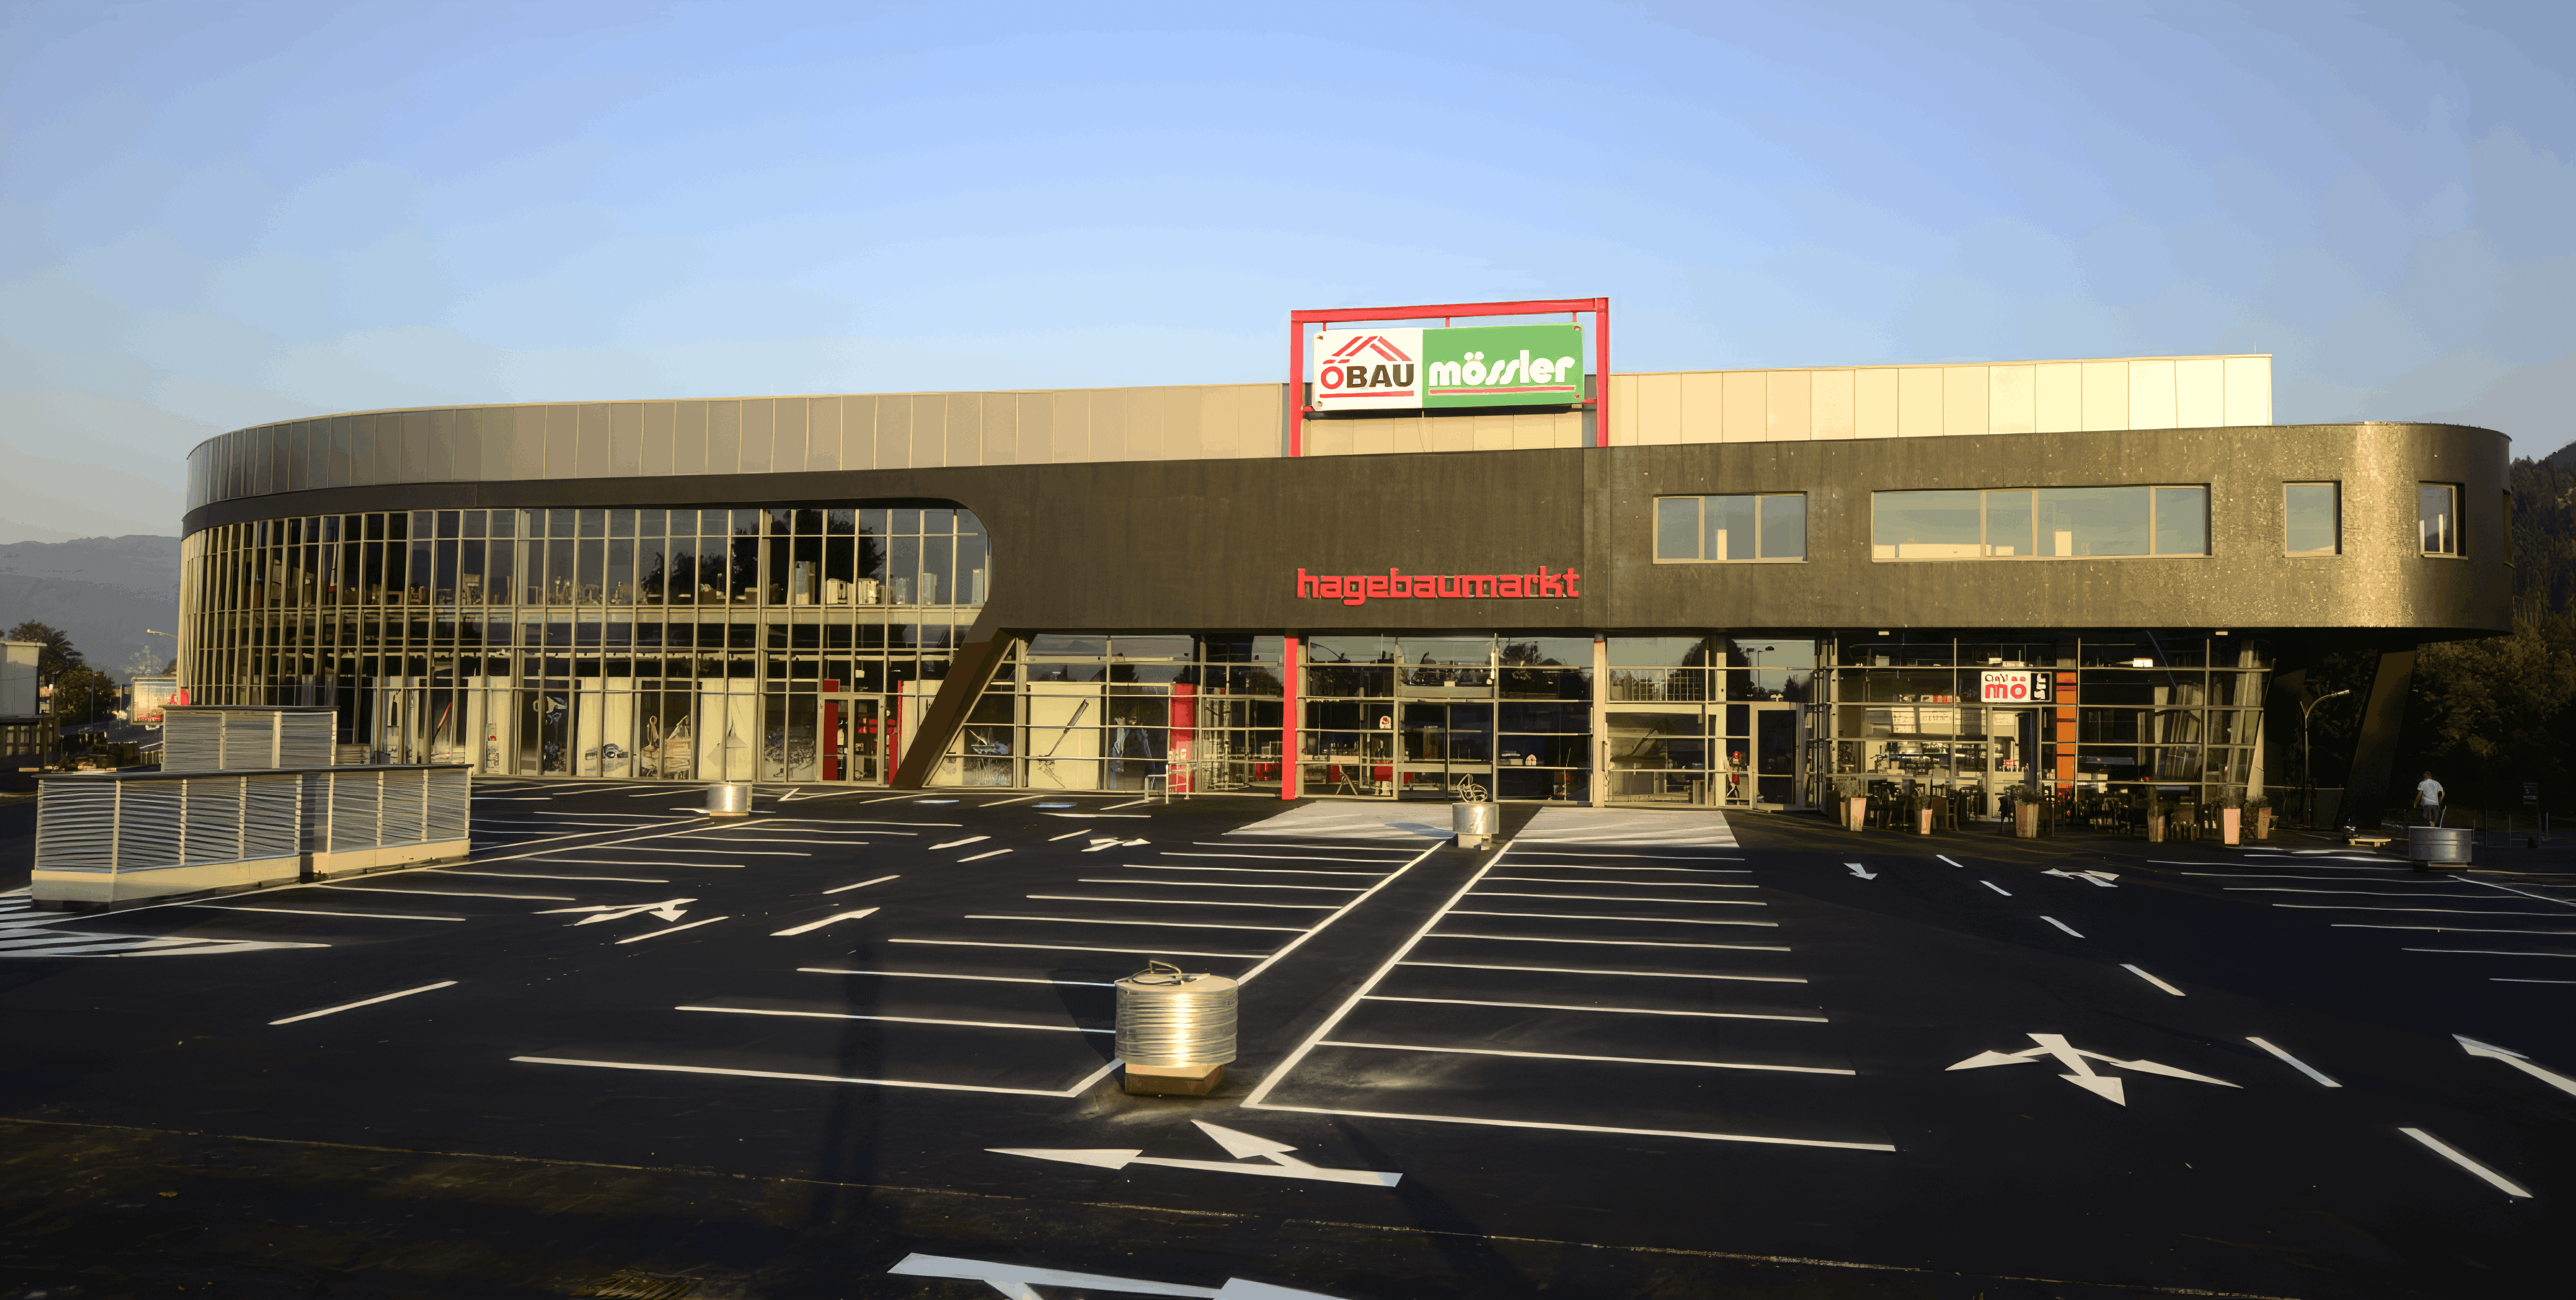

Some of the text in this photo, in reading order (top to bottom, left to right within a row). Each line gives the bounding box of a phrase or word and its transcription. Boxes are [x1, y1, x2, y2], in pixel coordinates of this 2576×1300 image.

[1320, 359, 1414, 390] ÖBAU
[1429, 350, 1575, 386] mössler
[1297, 566, 1579, 606] hagebaumarkt
